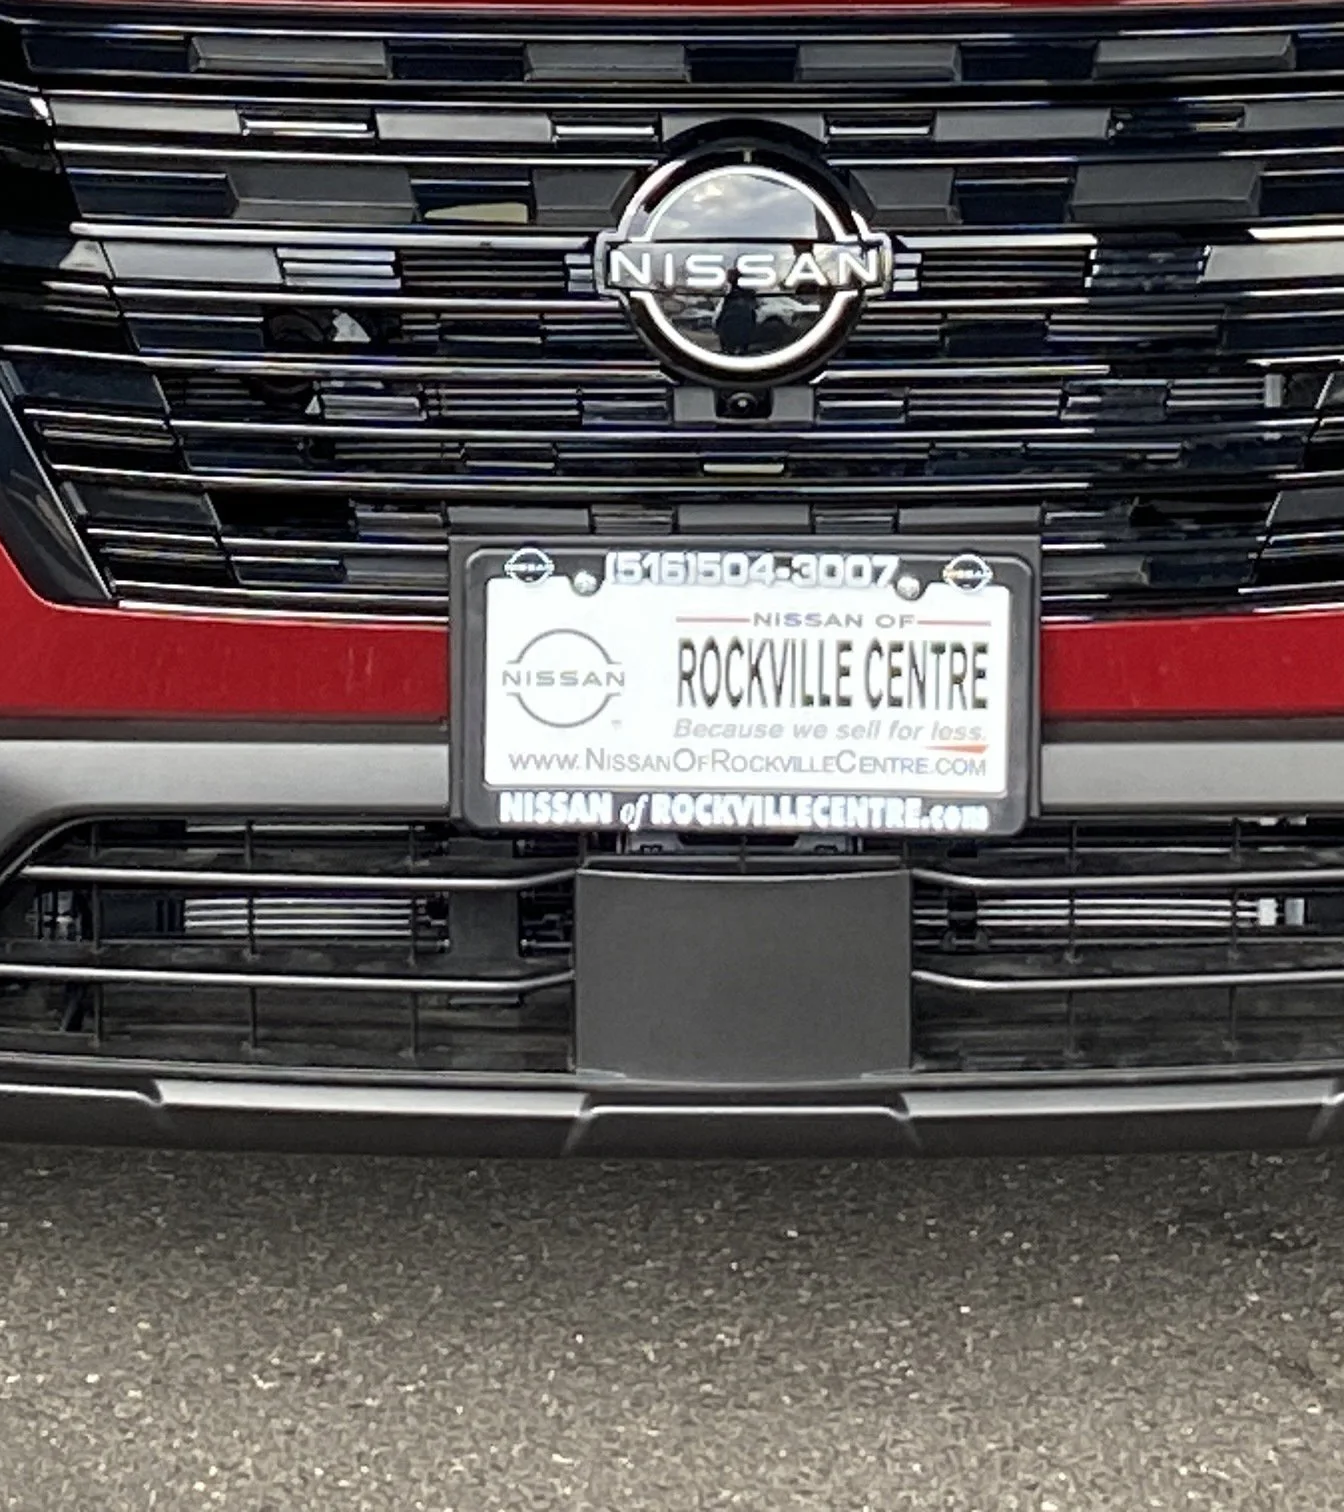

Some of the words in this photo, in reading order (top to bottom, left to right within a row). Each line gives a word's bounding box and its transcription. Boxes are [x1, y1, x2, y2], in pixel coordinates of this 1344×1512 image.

[610, 250, 879, 288] NISSAN
[606, 551, 899, 588] (516)504-3007
[753, 611, 863, 629] NISSAN
[875, 613, 916, 629] OF
[501, 670, 626, 687] NISSAN
[677, 637, 853, 709] ROCKVILLE
[864, 638, 989, 711] CENTRE
[673, 718, 784, 739] Because
[793, 722, 829, 740] we
[837, 720, 882, 741] sell
[889, 719, 924, 741] for
[931, 721, 987, 742] less.
[500, 791, 613, 824] NISSAN
[619, 794, 649, 832] of
